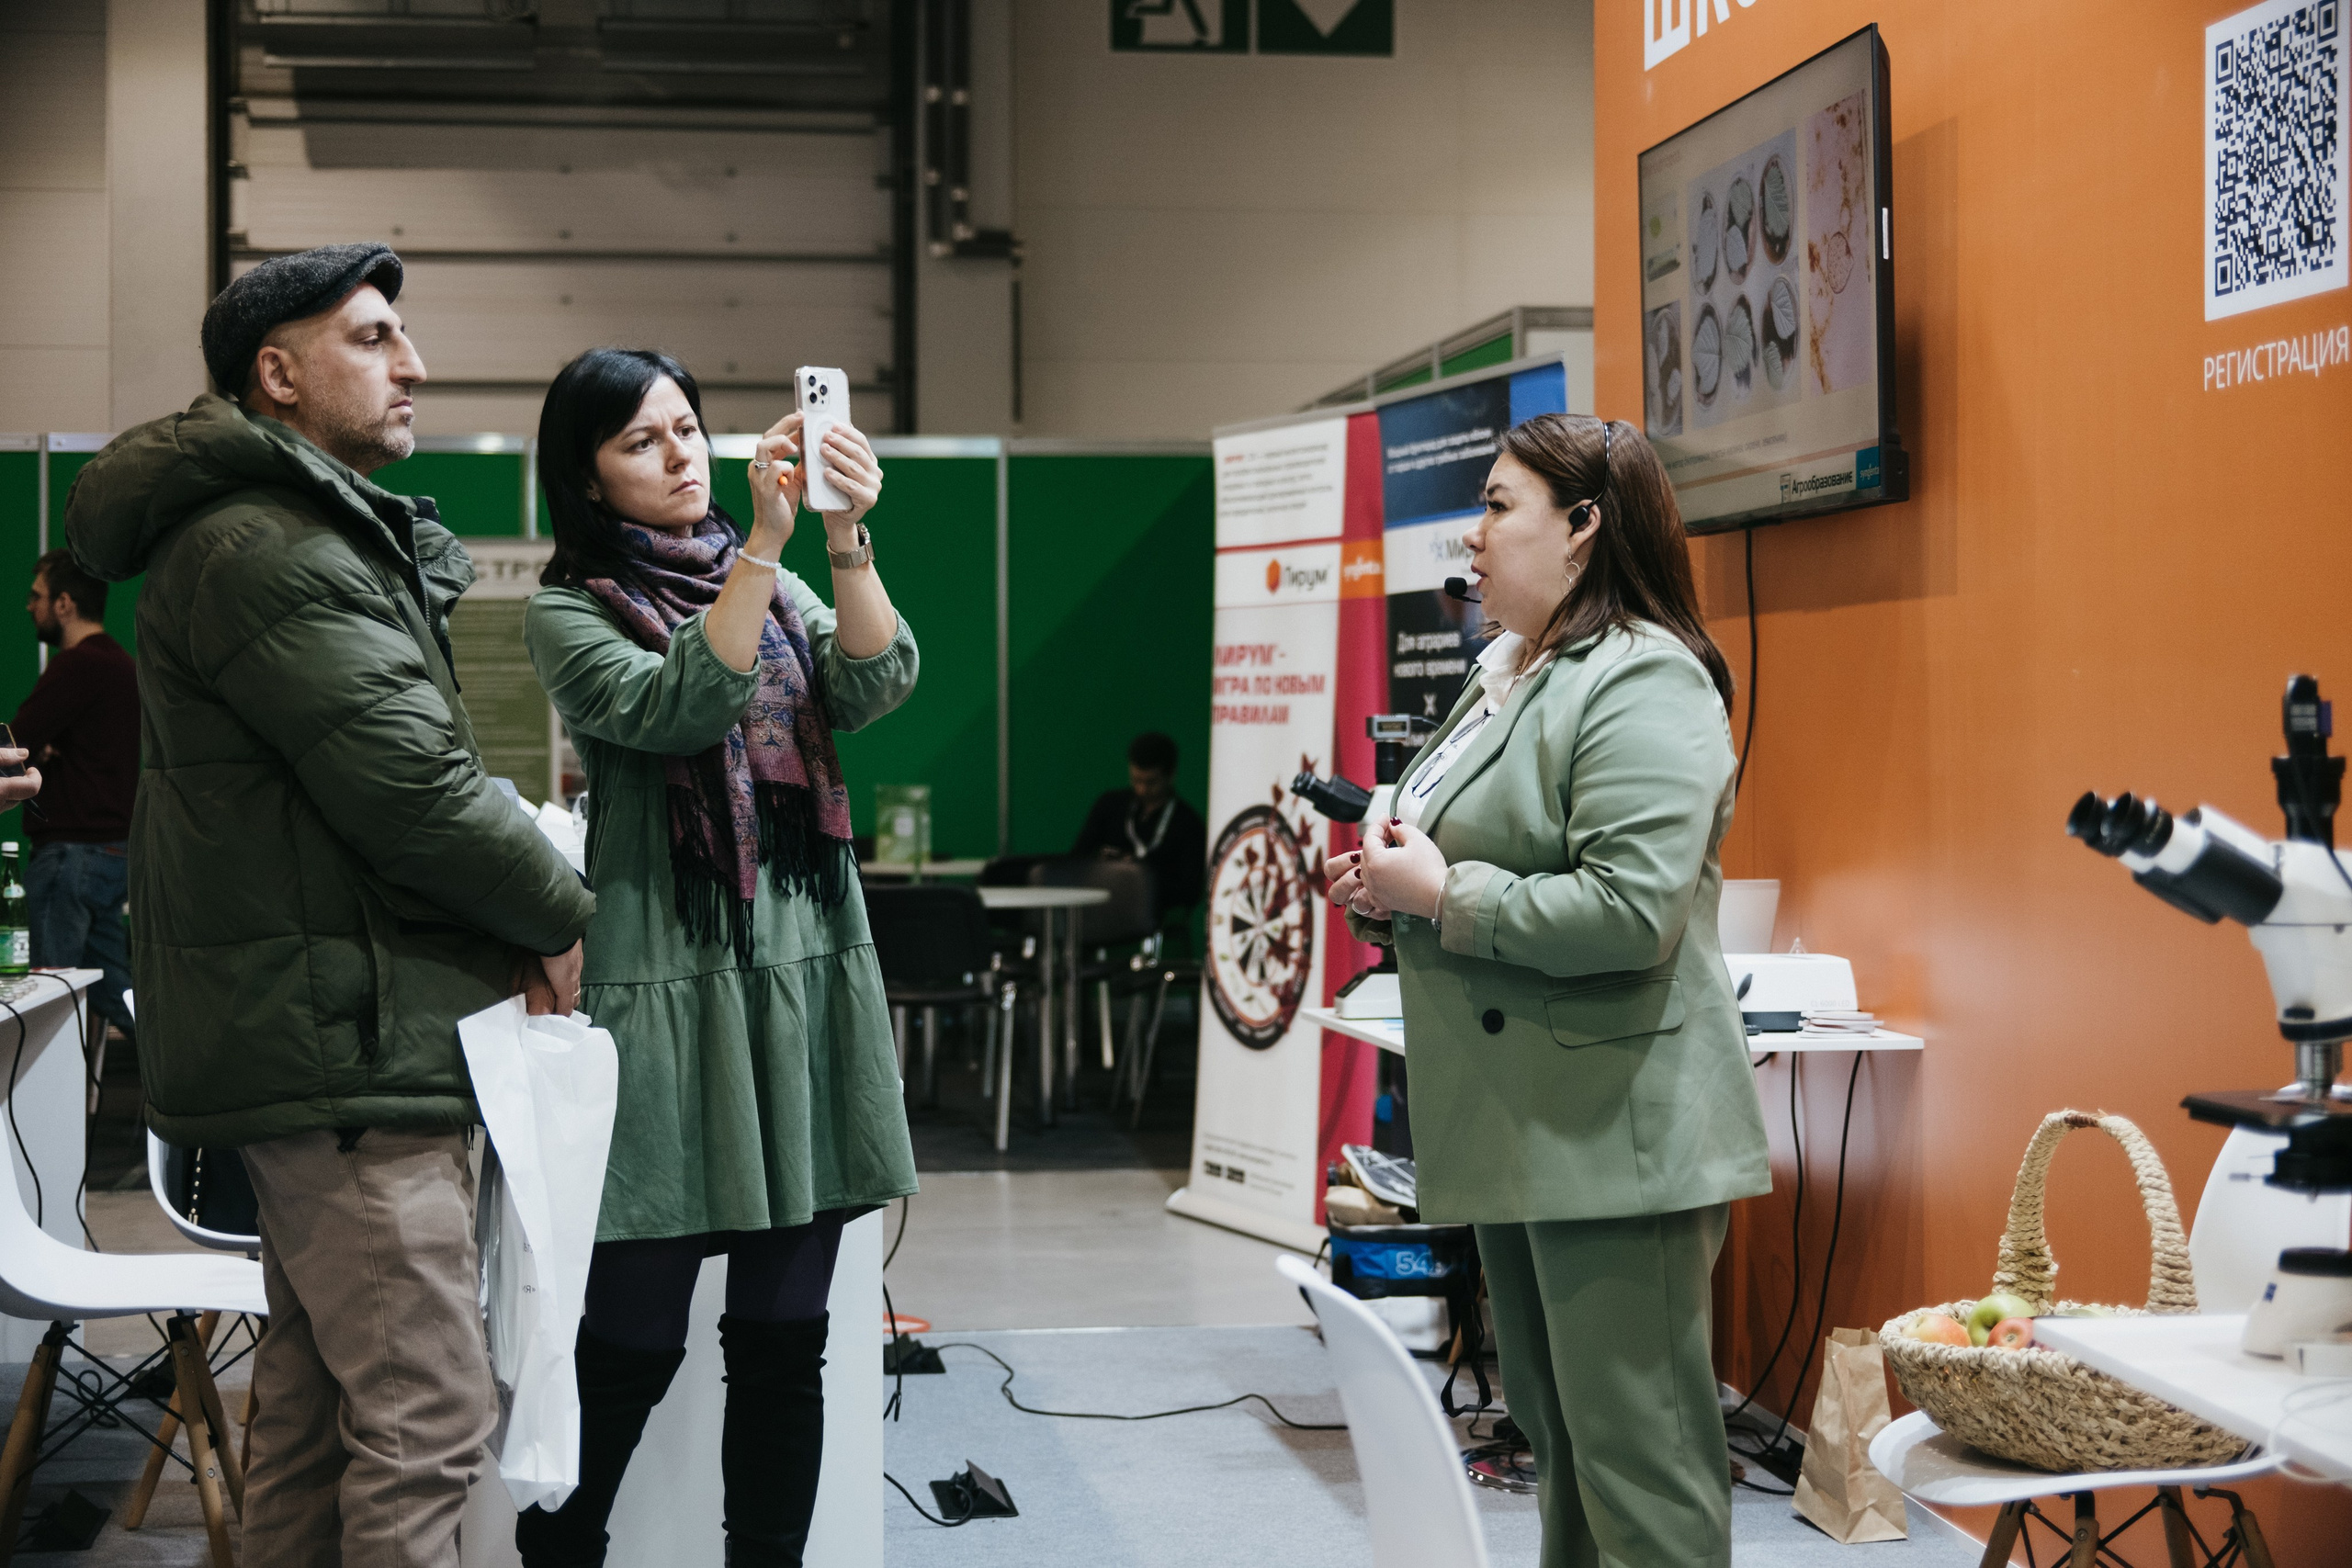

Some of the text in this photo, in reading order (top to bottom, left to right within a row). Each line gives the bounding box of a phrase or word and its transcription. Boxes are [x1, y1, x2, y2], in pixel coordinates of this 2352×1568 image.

[2204, 325, 2349, 392] РЕГИСТРАЦИЯ
[1792, 470, 1853, 497] Агрообразование
[1396, 631, 1461, 654] Для аграриев
[1394, 659, 1466, 680] нового времени
